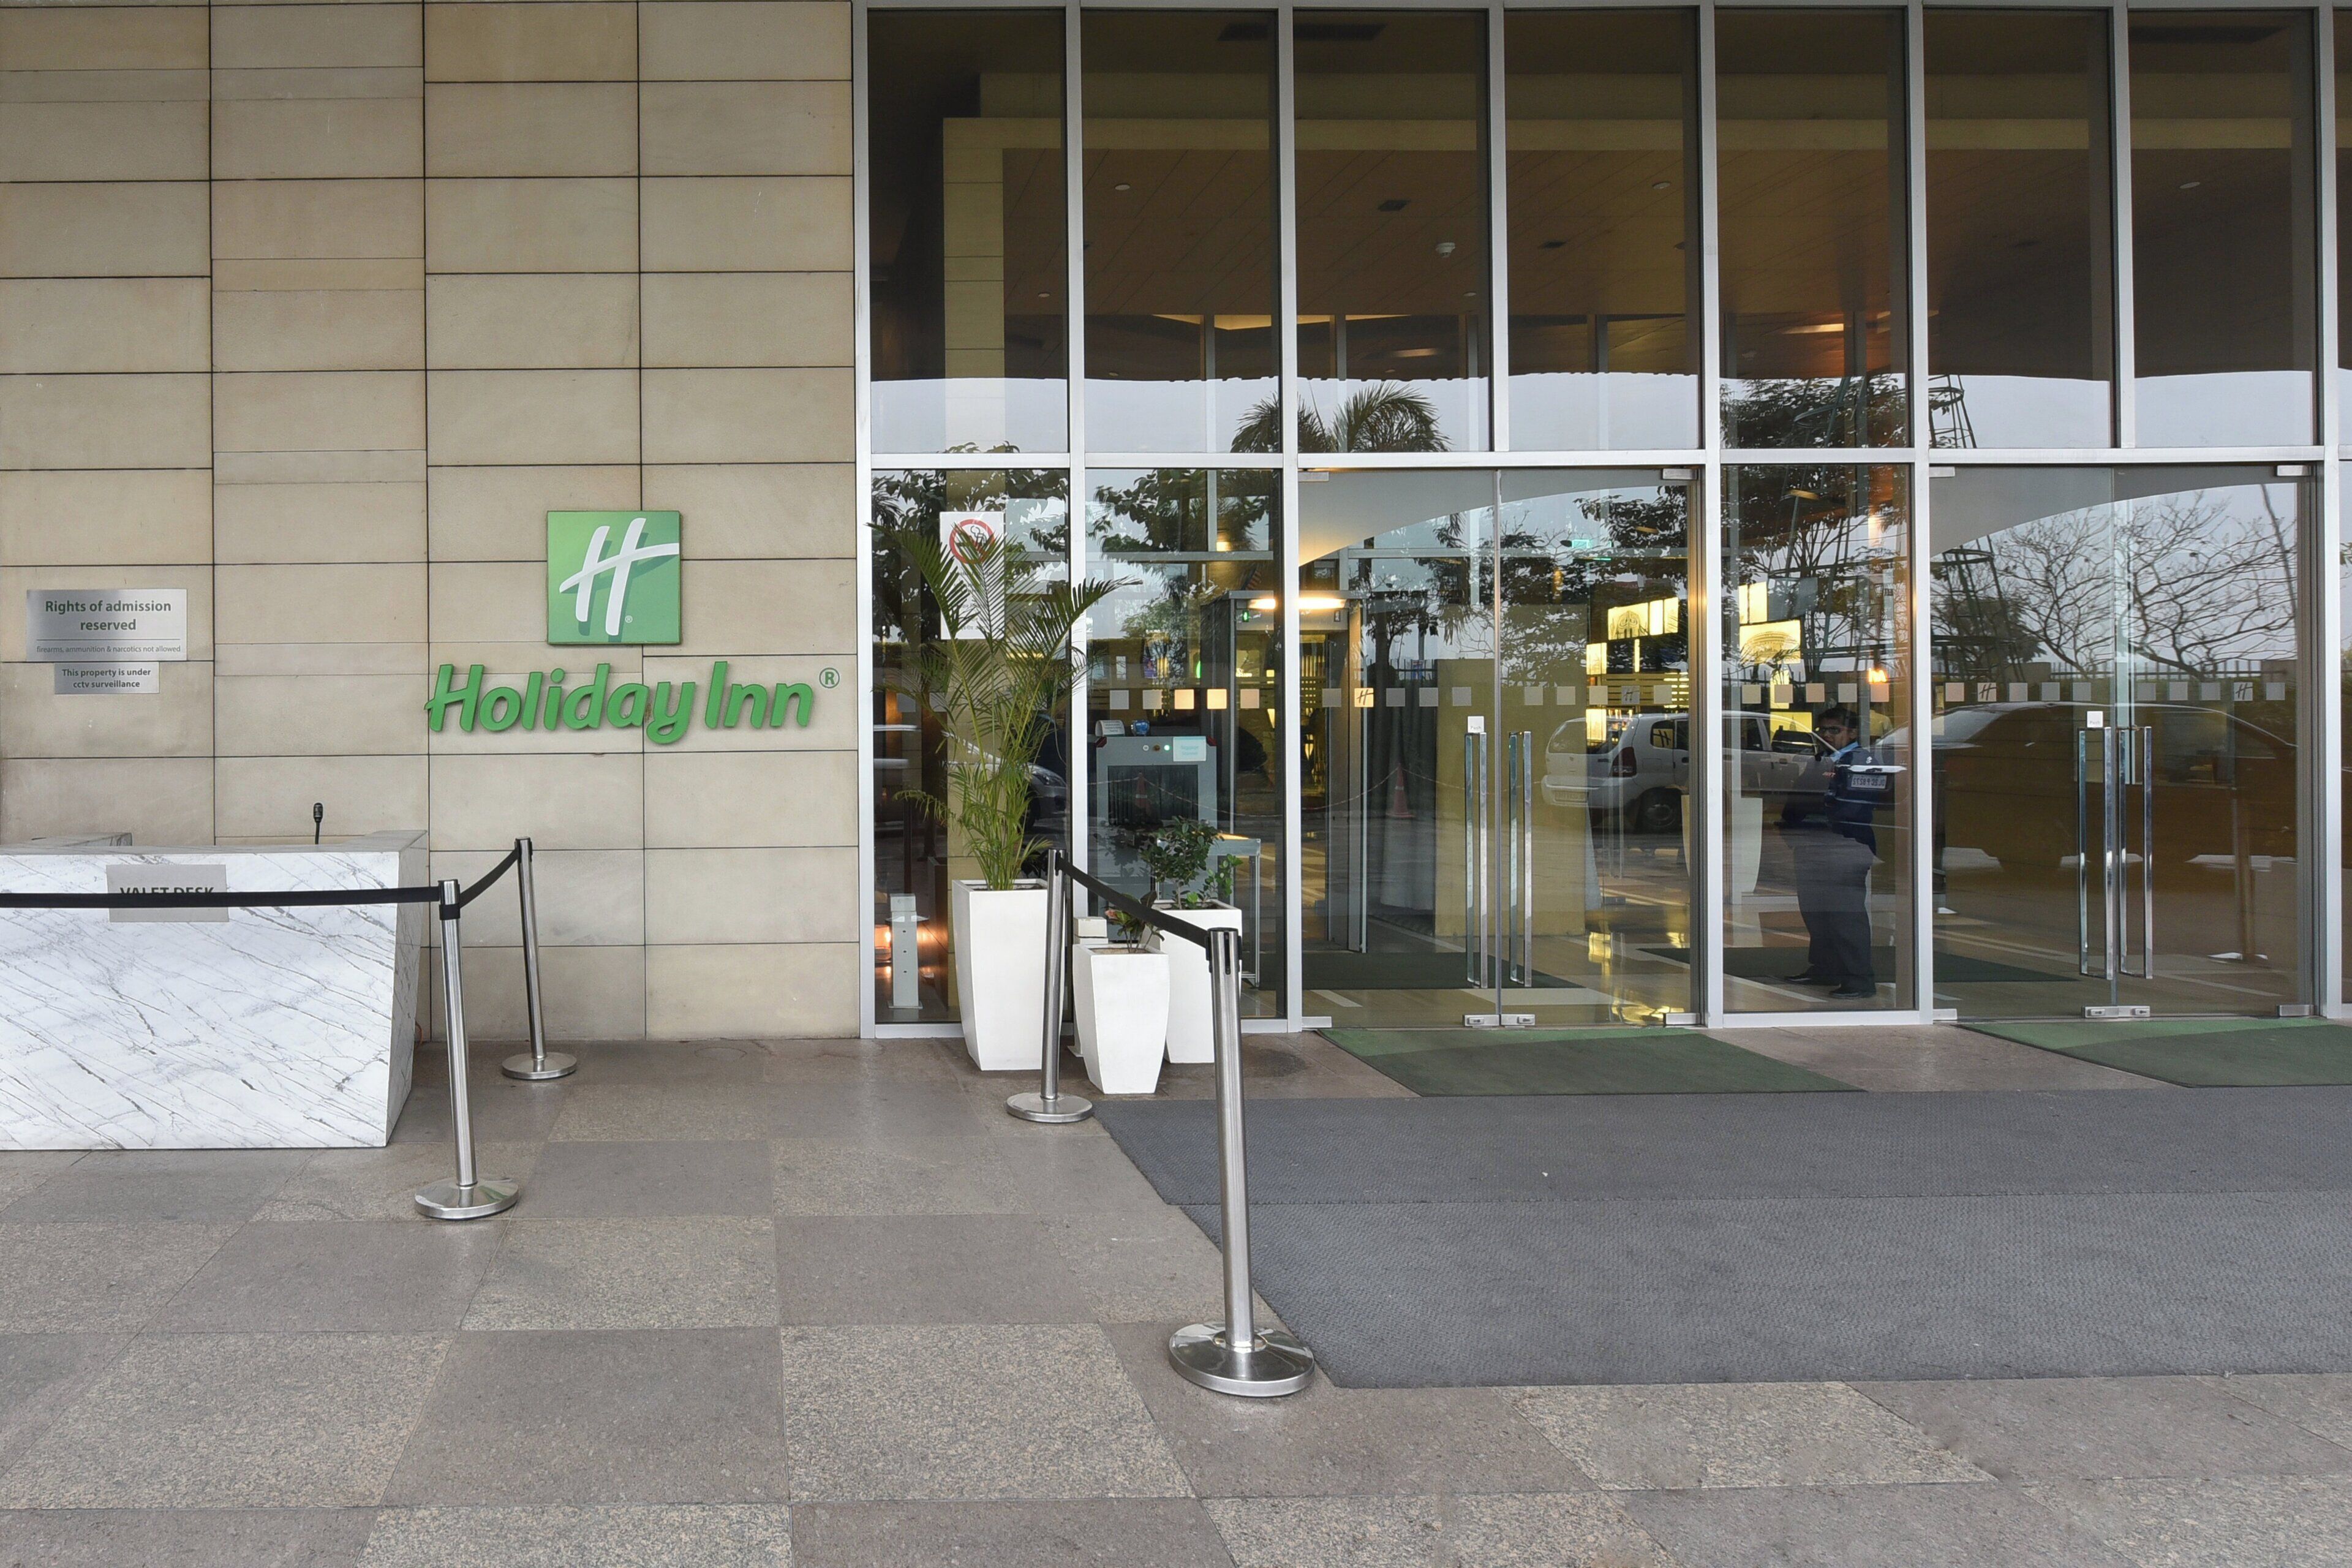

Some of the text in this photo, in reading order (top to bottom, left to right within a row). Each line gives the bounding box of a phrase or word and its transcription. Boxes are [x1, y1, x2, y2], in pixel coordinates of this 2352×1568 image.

[45, 600, 172, 615] Rights of admission
[80, 619, 136, 630] reserved
[81, 669, 117, 678] property
[423, 663, 696, 745] Holiday
[704, 661, 814, 729] Inn
